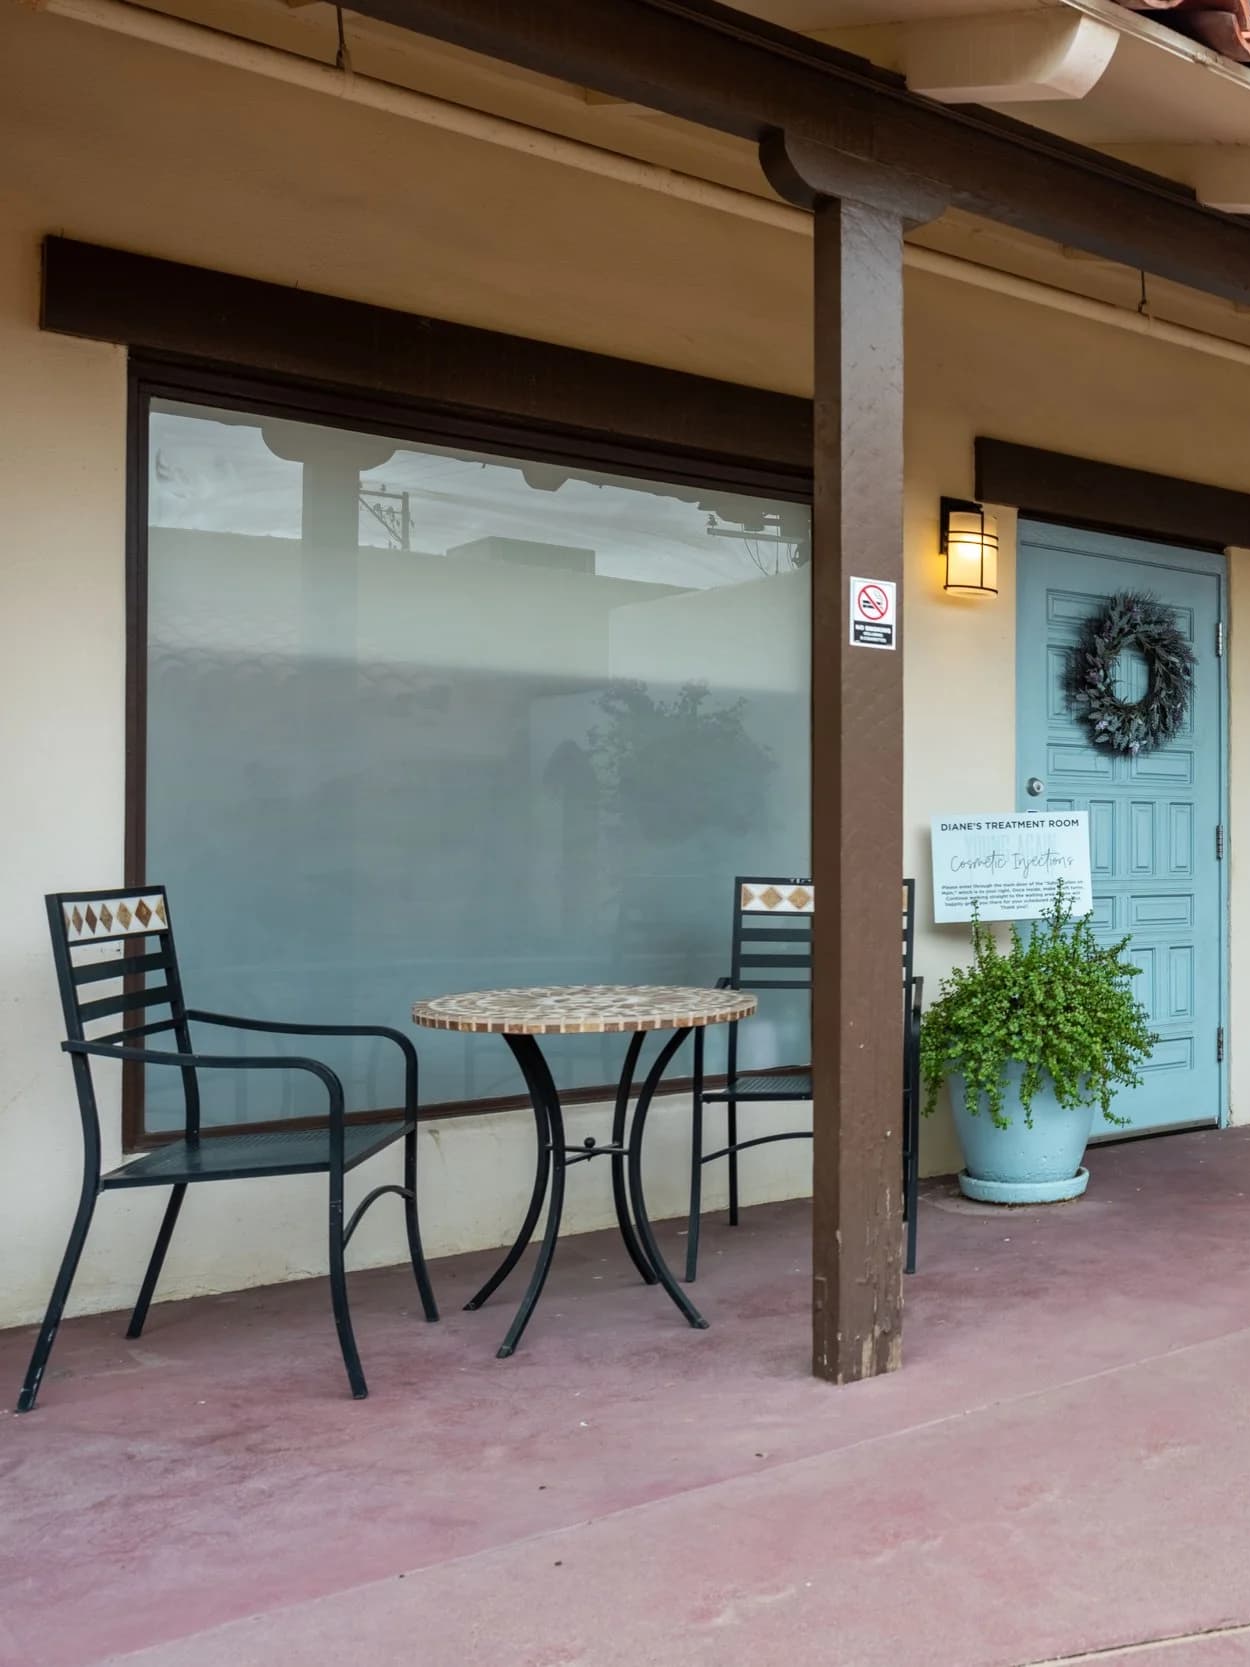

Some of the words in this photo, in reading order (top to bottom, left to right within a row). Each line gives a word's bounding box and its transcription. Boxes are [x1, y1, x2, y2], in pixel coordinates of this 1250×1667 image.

[941, 822, 982, 832] DIANE'S
[985, 820, 1046, 830] TREATMENT
[1049, 819, 1079, 828] ROOM
[950, 850, 1007, 875] Cosmetic
[1012, 848, 1075, 879] Injections
